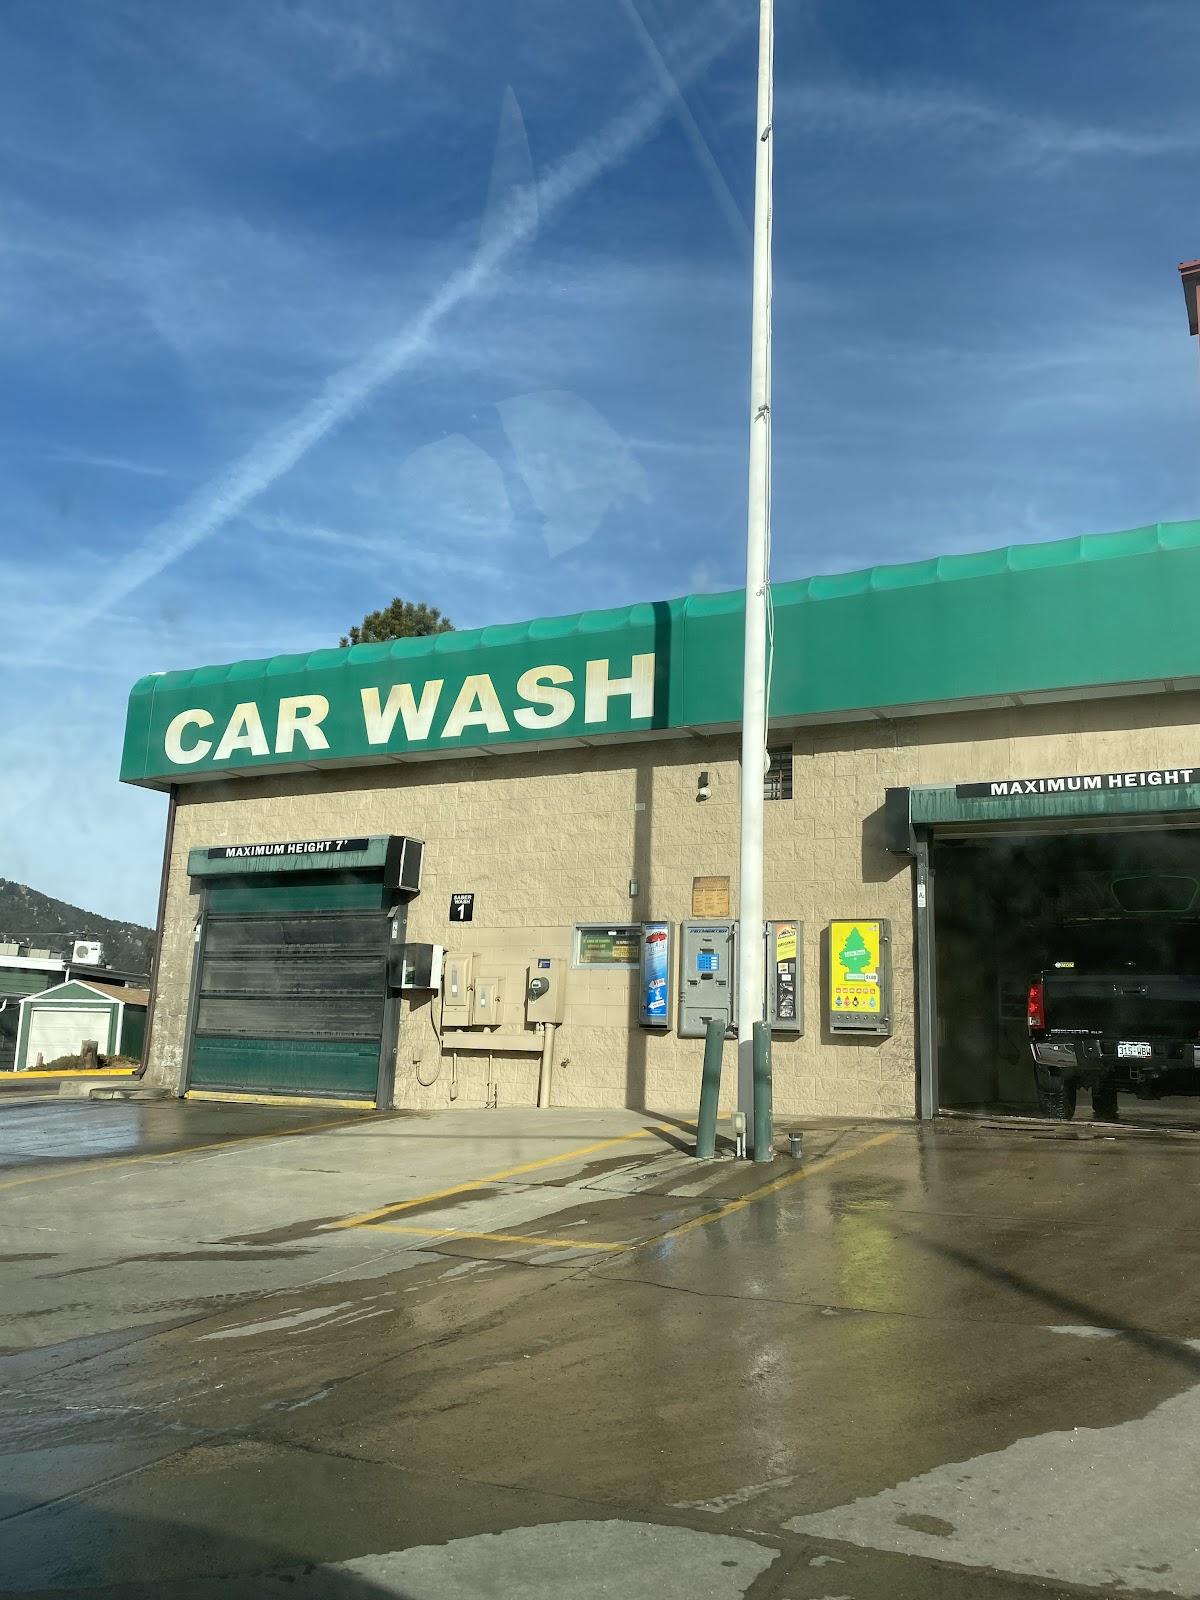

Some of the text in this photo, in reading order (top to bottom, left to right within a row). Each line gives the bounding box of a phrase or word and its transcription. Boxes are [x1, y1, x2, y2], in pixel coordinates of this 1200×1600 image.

[164, 652, 656, 765] CAR WASH
[990, 769, 1194, 796] MAXIMUM HEIGHT
[225, 839, 349, 858] MAXIMUM HEIGHT 7'
[457, 903, 465, 920] 1
